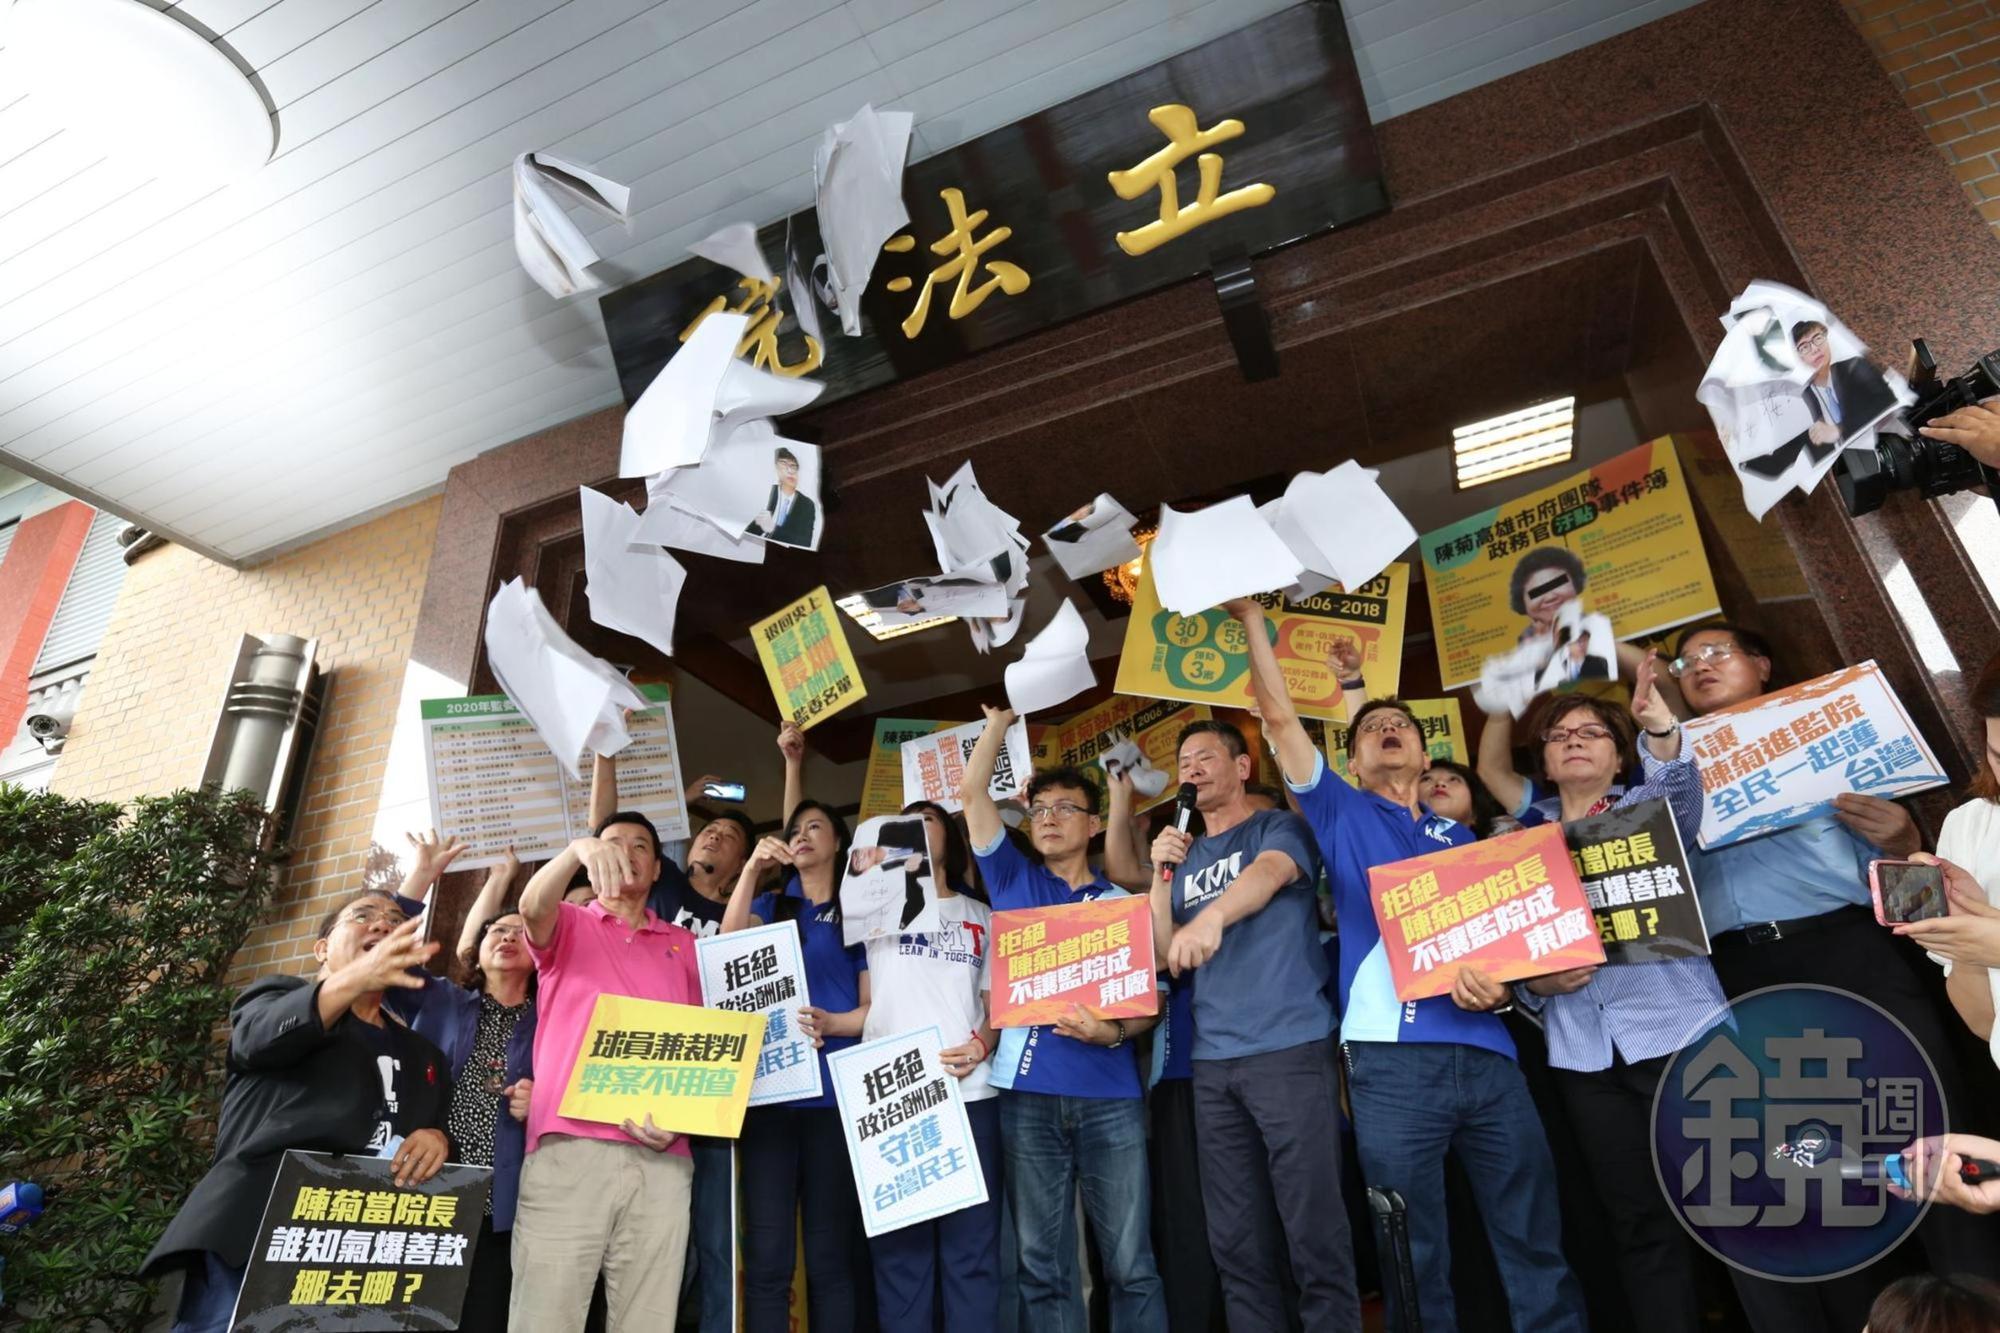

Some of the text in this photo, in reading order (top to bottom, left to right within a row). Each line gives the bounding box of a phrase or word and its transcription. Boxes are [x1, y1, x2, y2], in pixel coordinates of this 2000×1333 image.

[1434, 477, 1604, 565] 陳菊高雄市府團隊
[764, 597, 823, 642] 退回史上
[1702, 693, 1865, 794] 陳菊進監院
[1711, 718, 1880, 822] 全民一起護
[1844, 734, 1923, 792] 台灣
[1380, 870, 1440, 921] 拒絕
[1399, 853, 1549, 945] 陳菊當院長
[899, 944, 923, 956] LEAN
[928, 948, 939, 959] IN
[998, 921, 1046, 958] 拒絕
[1008, 919, 1130, 981] 陳菊當院長
[1407, 884, 1561, 972] 不讓監院成
[1523, 908, 1592, 961] 東廠
[723, 943, 779, 992] 拒絕
[1008, 946, 1132, 1006] 不讓監院成
[1098, 969, 1150, 1008] 東廠
[588, 1030, 749, 1062] 球員兼裁判
[578, 1063, 740, 1097] 弊案不用查
[862, 1047, 926, 1105] 拒絕
[856, 1076, 949, 1142] 政治酬庸
[877, 1113, 943, 1167] 守護
[872, 1146, 967, 1212] 台灣民主
[291, 1185, 459, 1228] 陳菊當院長
[265, 1225, 469, 1267] 誰知氣爆善款
